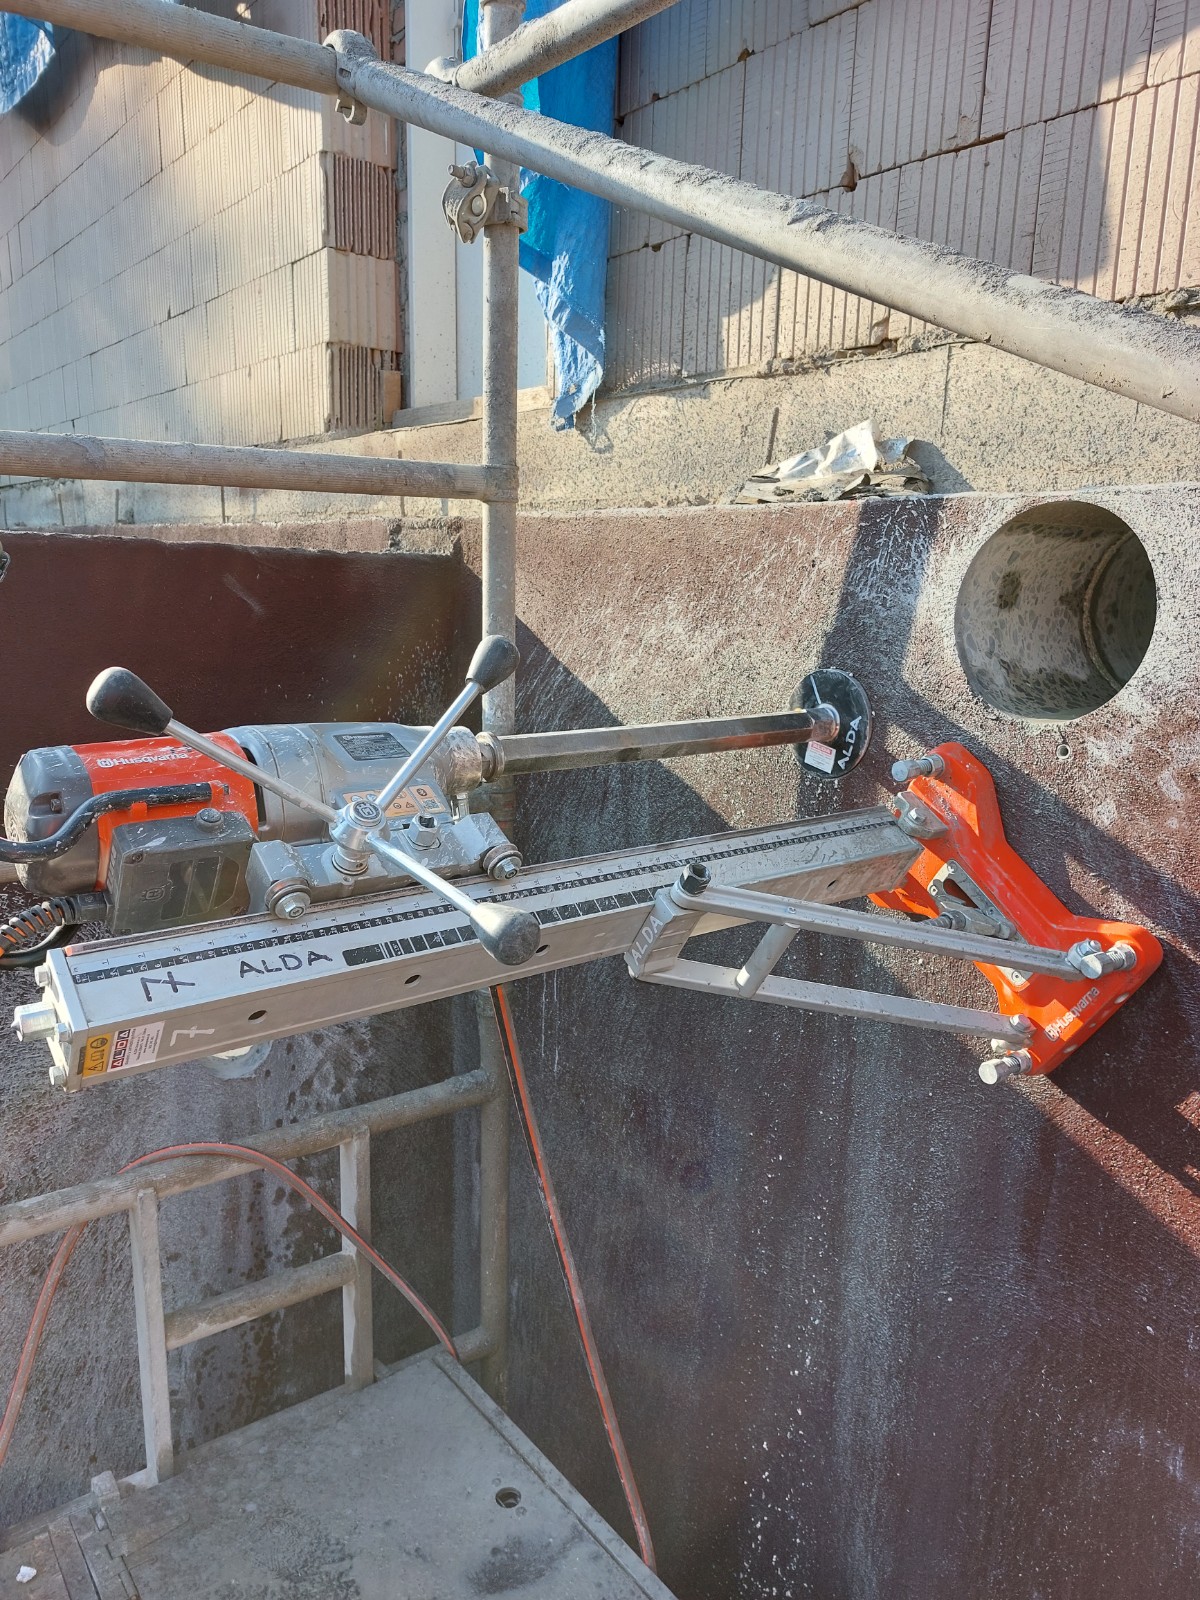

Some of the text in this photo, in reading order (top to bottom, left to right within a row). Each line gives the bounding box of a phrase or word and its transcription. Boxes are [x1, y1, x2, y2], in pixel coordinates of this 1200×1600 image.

[113, 752, 188, 765] Husqvarna
[838, 716, 862, 770] ALDA
[631, 916, 664, 966] ALDA
[239, 950, 334, 978] ALDA
[1053, 987, 1100, 1035] Husqvarna
[112, 1029, 131, 1068] ALDA
